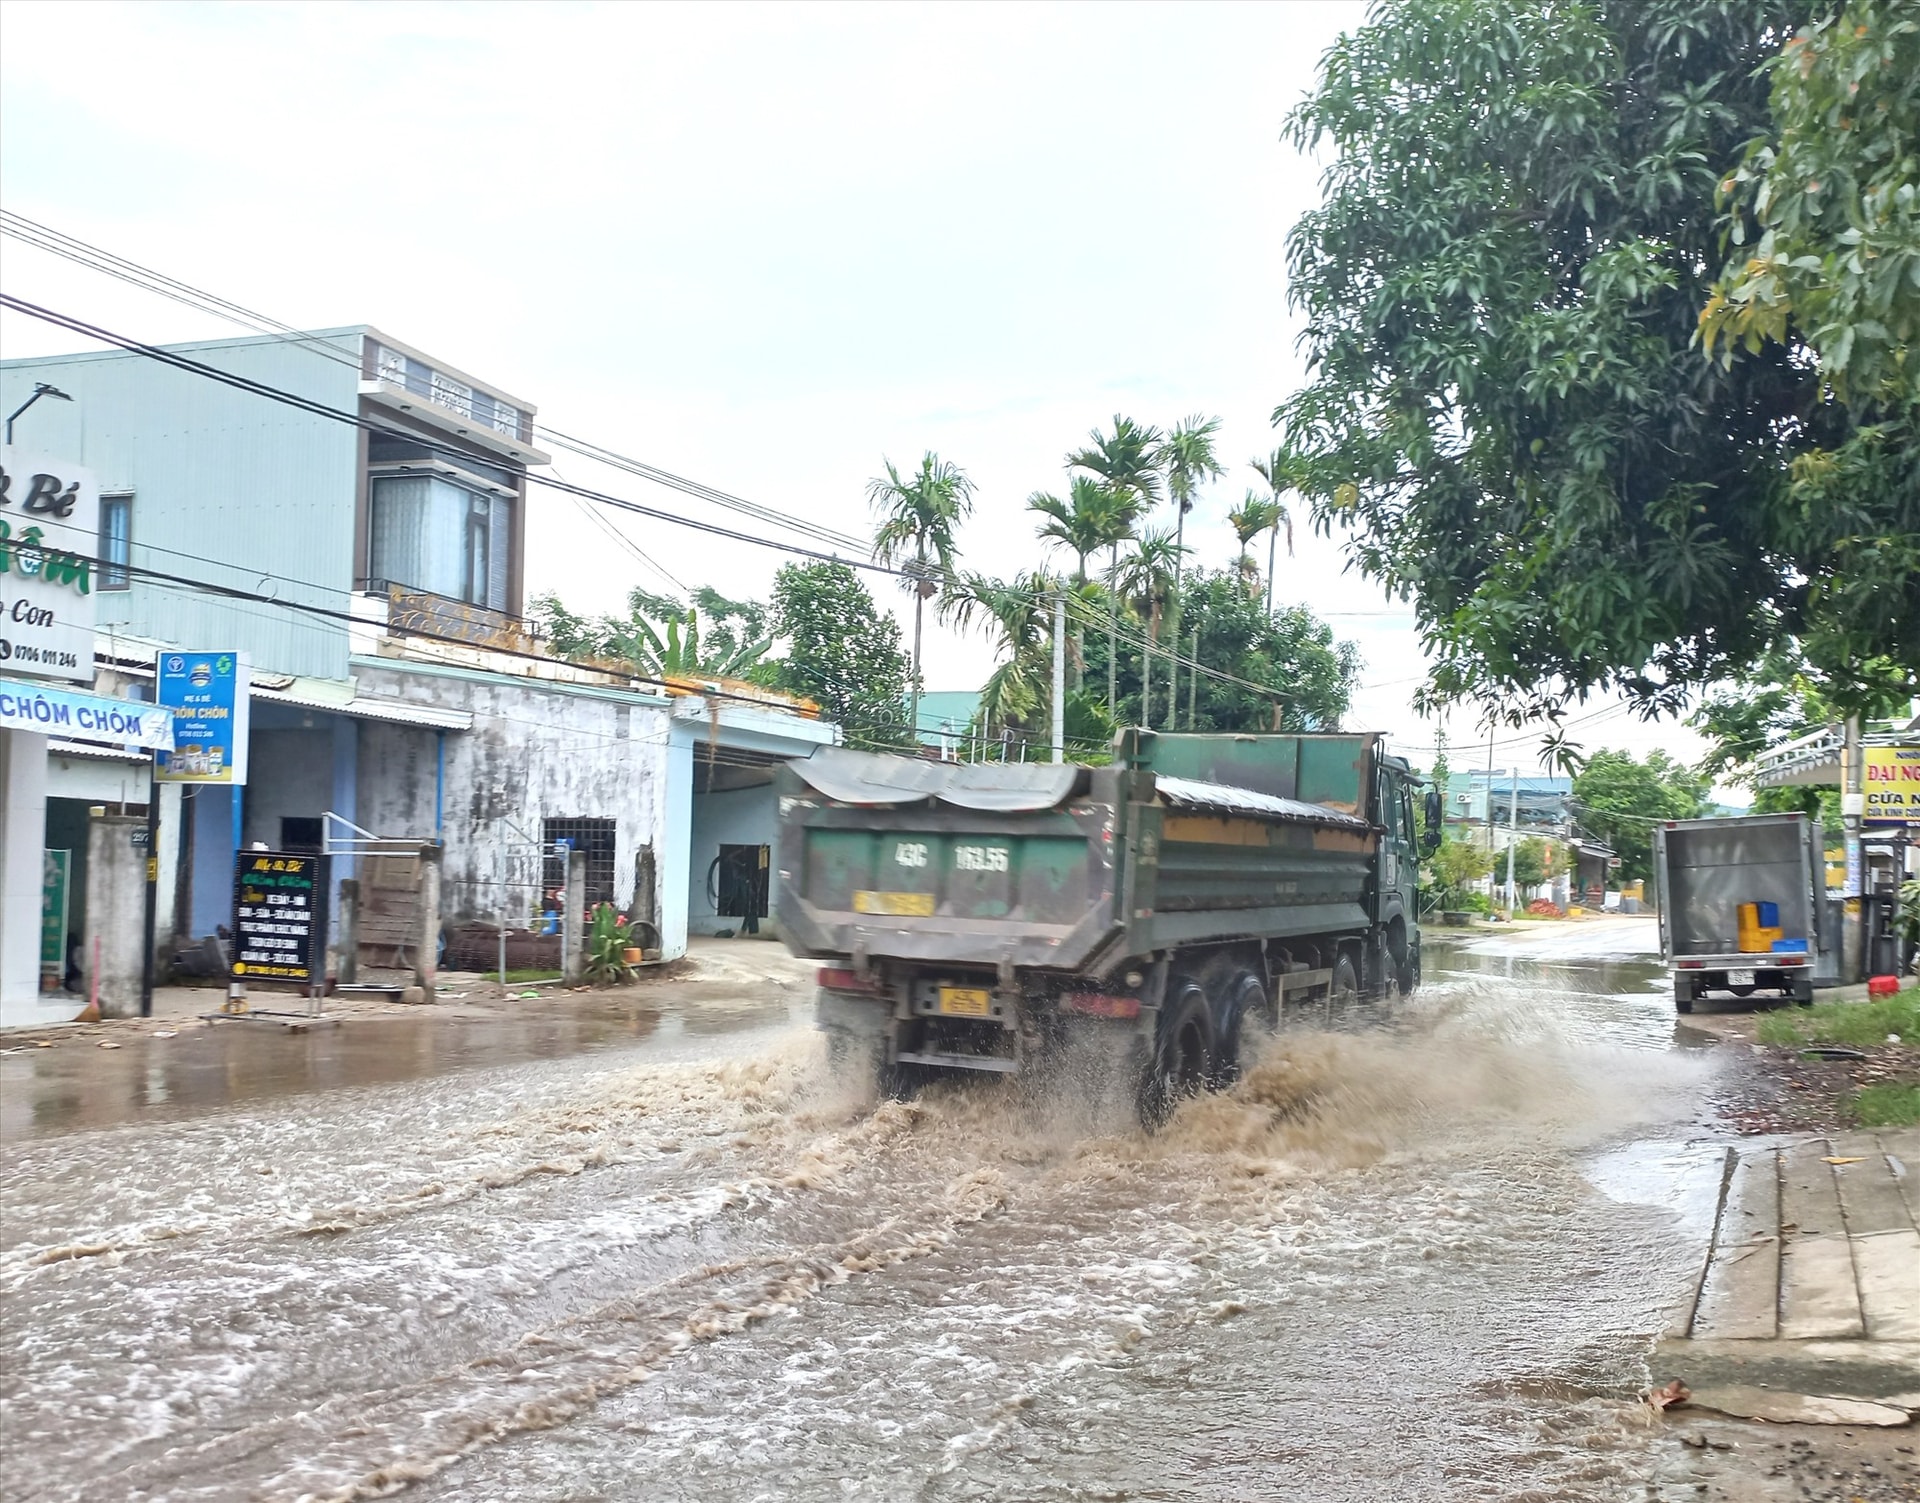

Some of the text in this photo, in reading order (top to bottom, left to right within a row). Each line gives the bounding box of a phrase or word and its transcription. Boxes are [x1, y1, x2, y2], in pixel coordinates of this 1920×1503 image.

[23, 474, 80, 518] Bé
[12, 599, 54, 627] Con
[15, 645, 77, 668] 0706 011 246
[0, 693, 142, 737] CHÔM CHÔM
[1868, 765, 1897, 785] ĐẠI
[1868, 790, 1904, 804] CỬA
[895, 843, 928, 867] 43C
